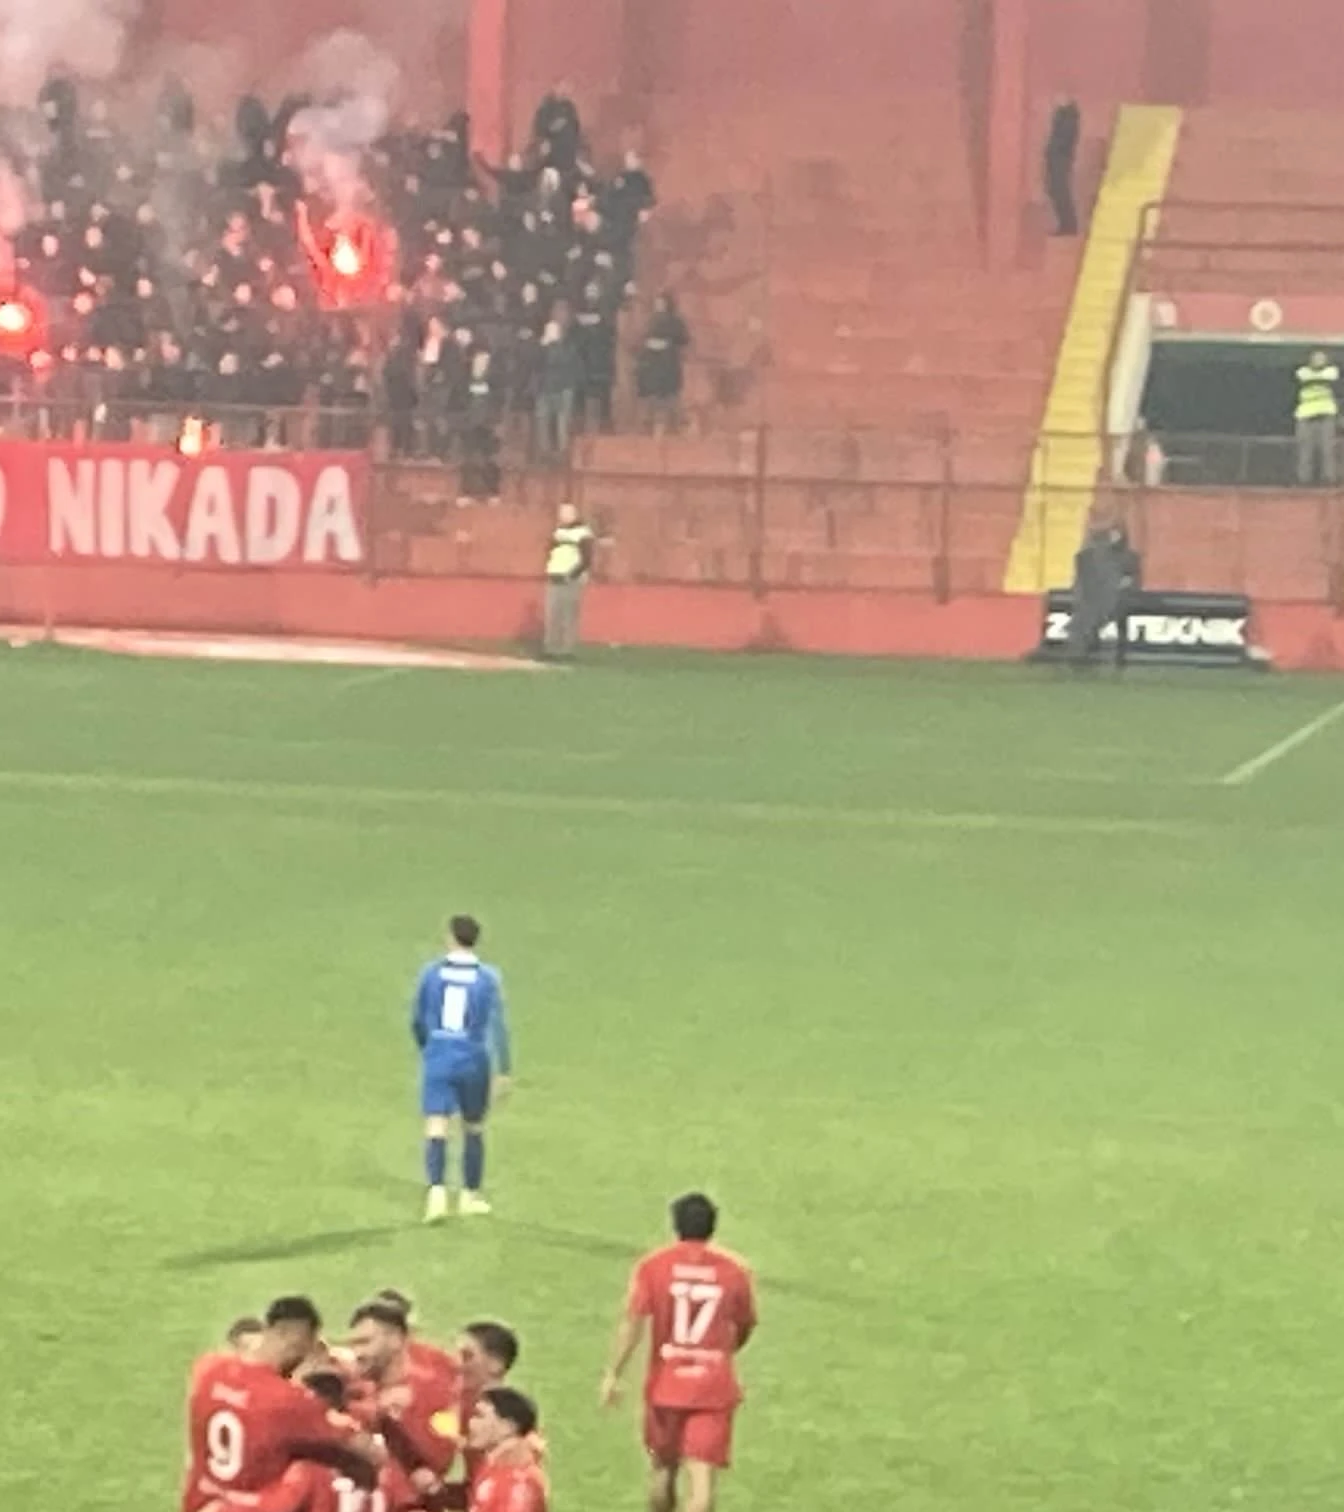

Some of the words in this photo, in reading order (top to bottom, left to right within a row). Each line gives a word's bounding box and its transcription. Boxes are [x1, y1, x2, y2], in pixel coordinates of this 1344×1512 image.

[48, 456, 362, 564] NIKADA
[669, 1282, 724, 1345] 17
[207, 1409, 244, 1481] 9
